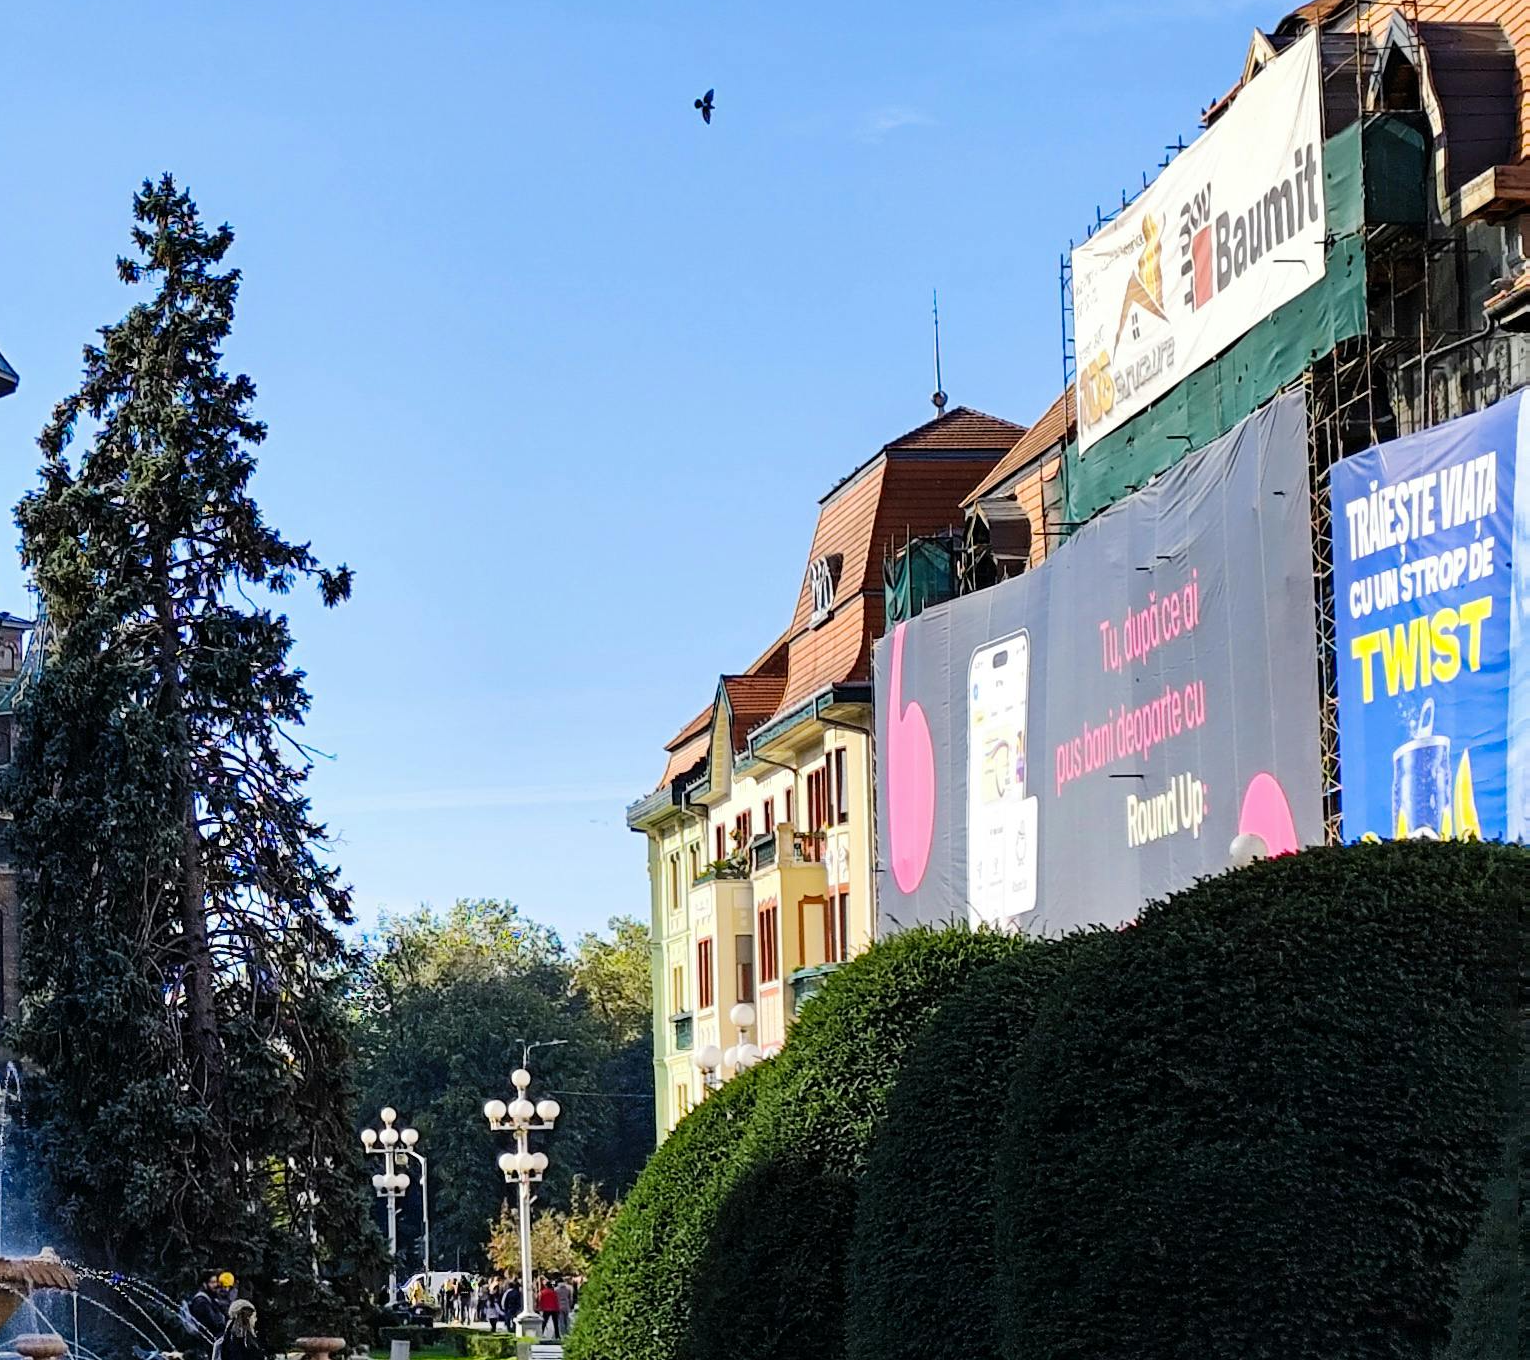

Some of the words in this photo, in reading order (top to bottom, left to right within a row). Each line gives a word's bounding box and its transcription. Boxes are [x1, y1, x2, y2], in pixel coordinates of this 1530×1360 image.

[1216, 143, 1318, 293] Baumit
[1346, 472, 1436, 563] TRĂIEȘTE
[1440, 451, 1497, 539] VIAȚA
[1099, 620, 1123, 675] Tu,
[1123, 590, 1160, 666] după
[1162, 592, 1181, 641] ce
[1183, 567, 1199, 630] ai
[1350, 577, 1372, 619] CU
[1374, 568, 1399, 610] UN
[1400, 547, 1468, 602] STROP
[1469, 537, 1495, 582] DE
[1351, 596, 1492, 703] TWIST
[1056, 737, 1082, 798] pus
[1084, 708, 1115, 773] bani
[1116, 685, 1182, 761] deoparte
[1184, 679, 1206, 729] cu
[1127, 776, 1178, 848] Round
[1179, 771, 1209, 839] Up:
